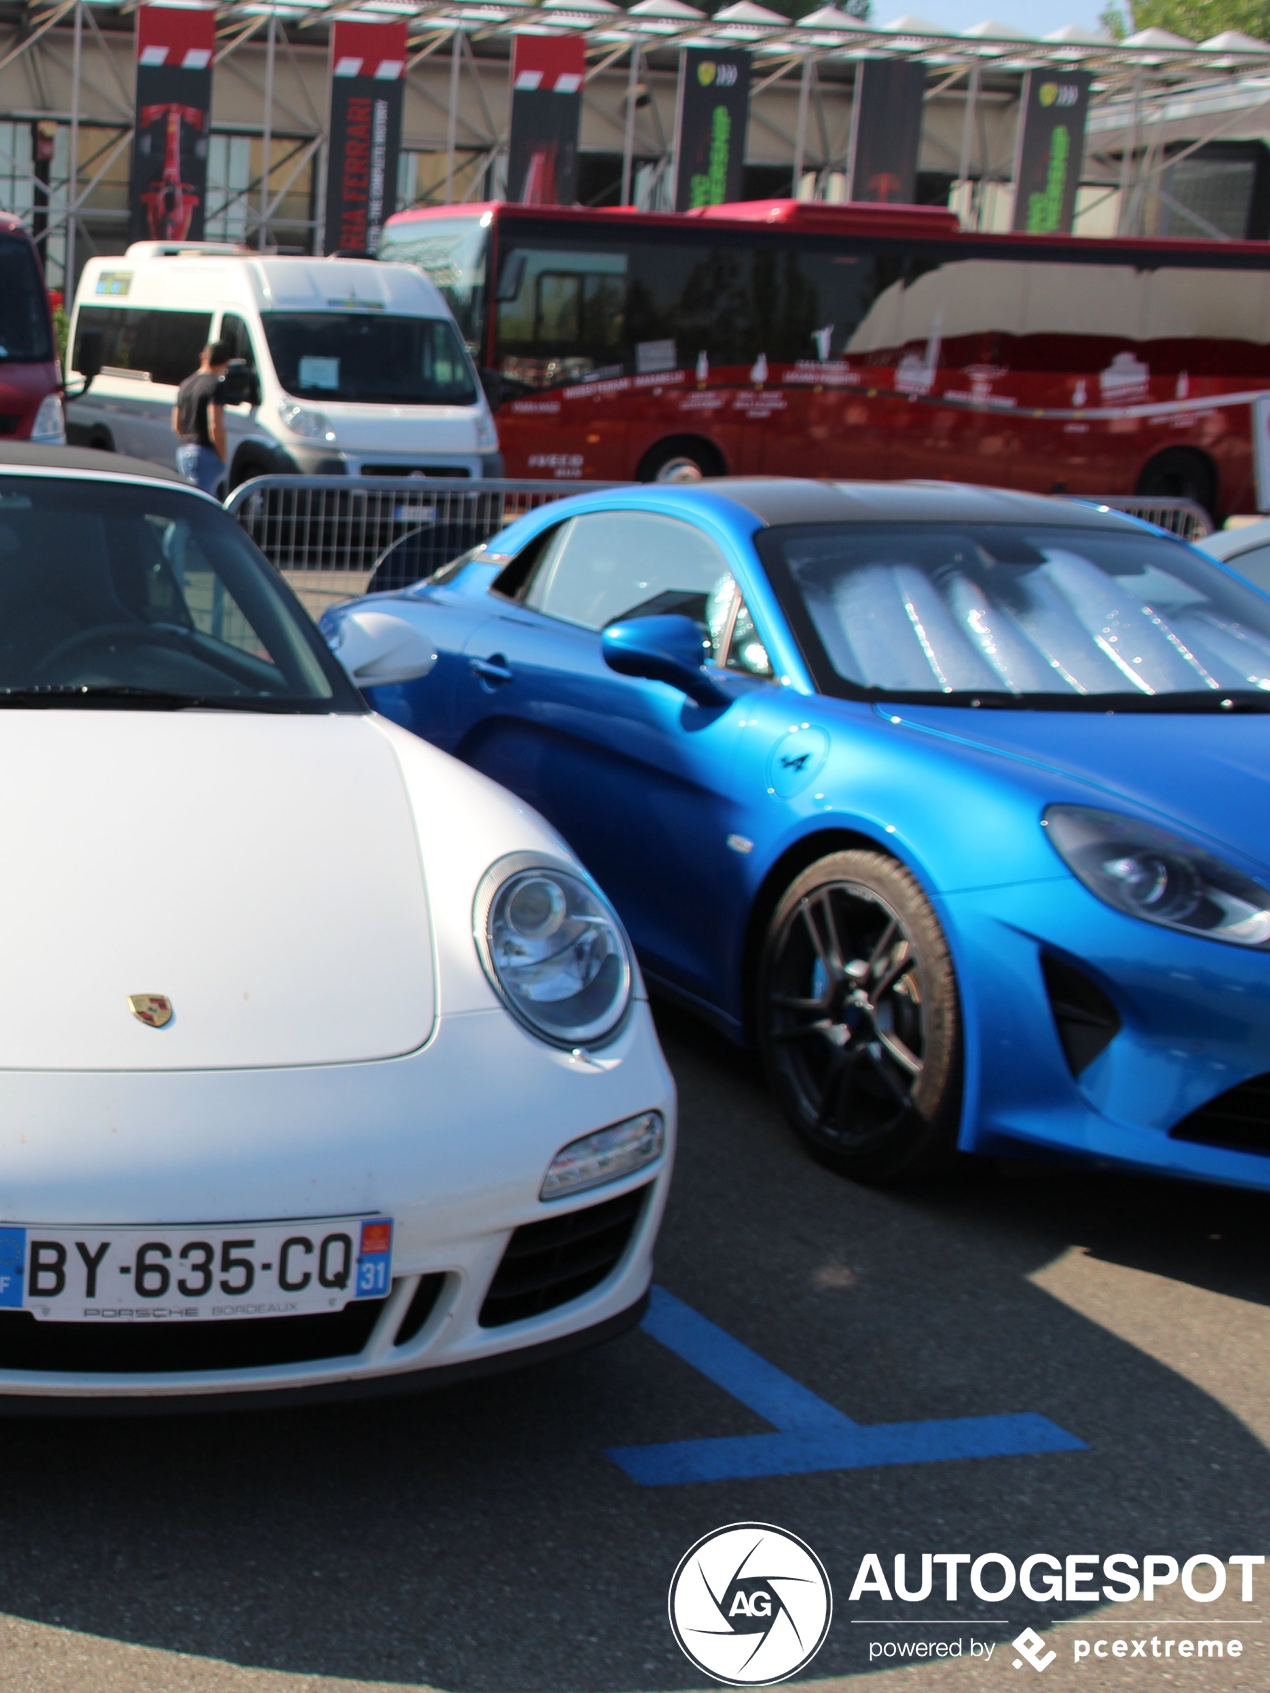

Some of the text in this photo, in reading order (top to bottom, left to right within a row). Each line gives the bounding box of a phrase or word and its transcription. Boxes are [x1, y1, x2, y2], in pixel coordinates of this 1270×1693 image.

[340, 97, 373, 251] RIA FERRARI
[528, 454, 584, 467] IVECO
[28, 1232, 352, 1298] BY-635-CQ
[361, 1262, 386, 1290] 31
[84, 1302, 298, 1318] PORSCHE BORDEAUX
